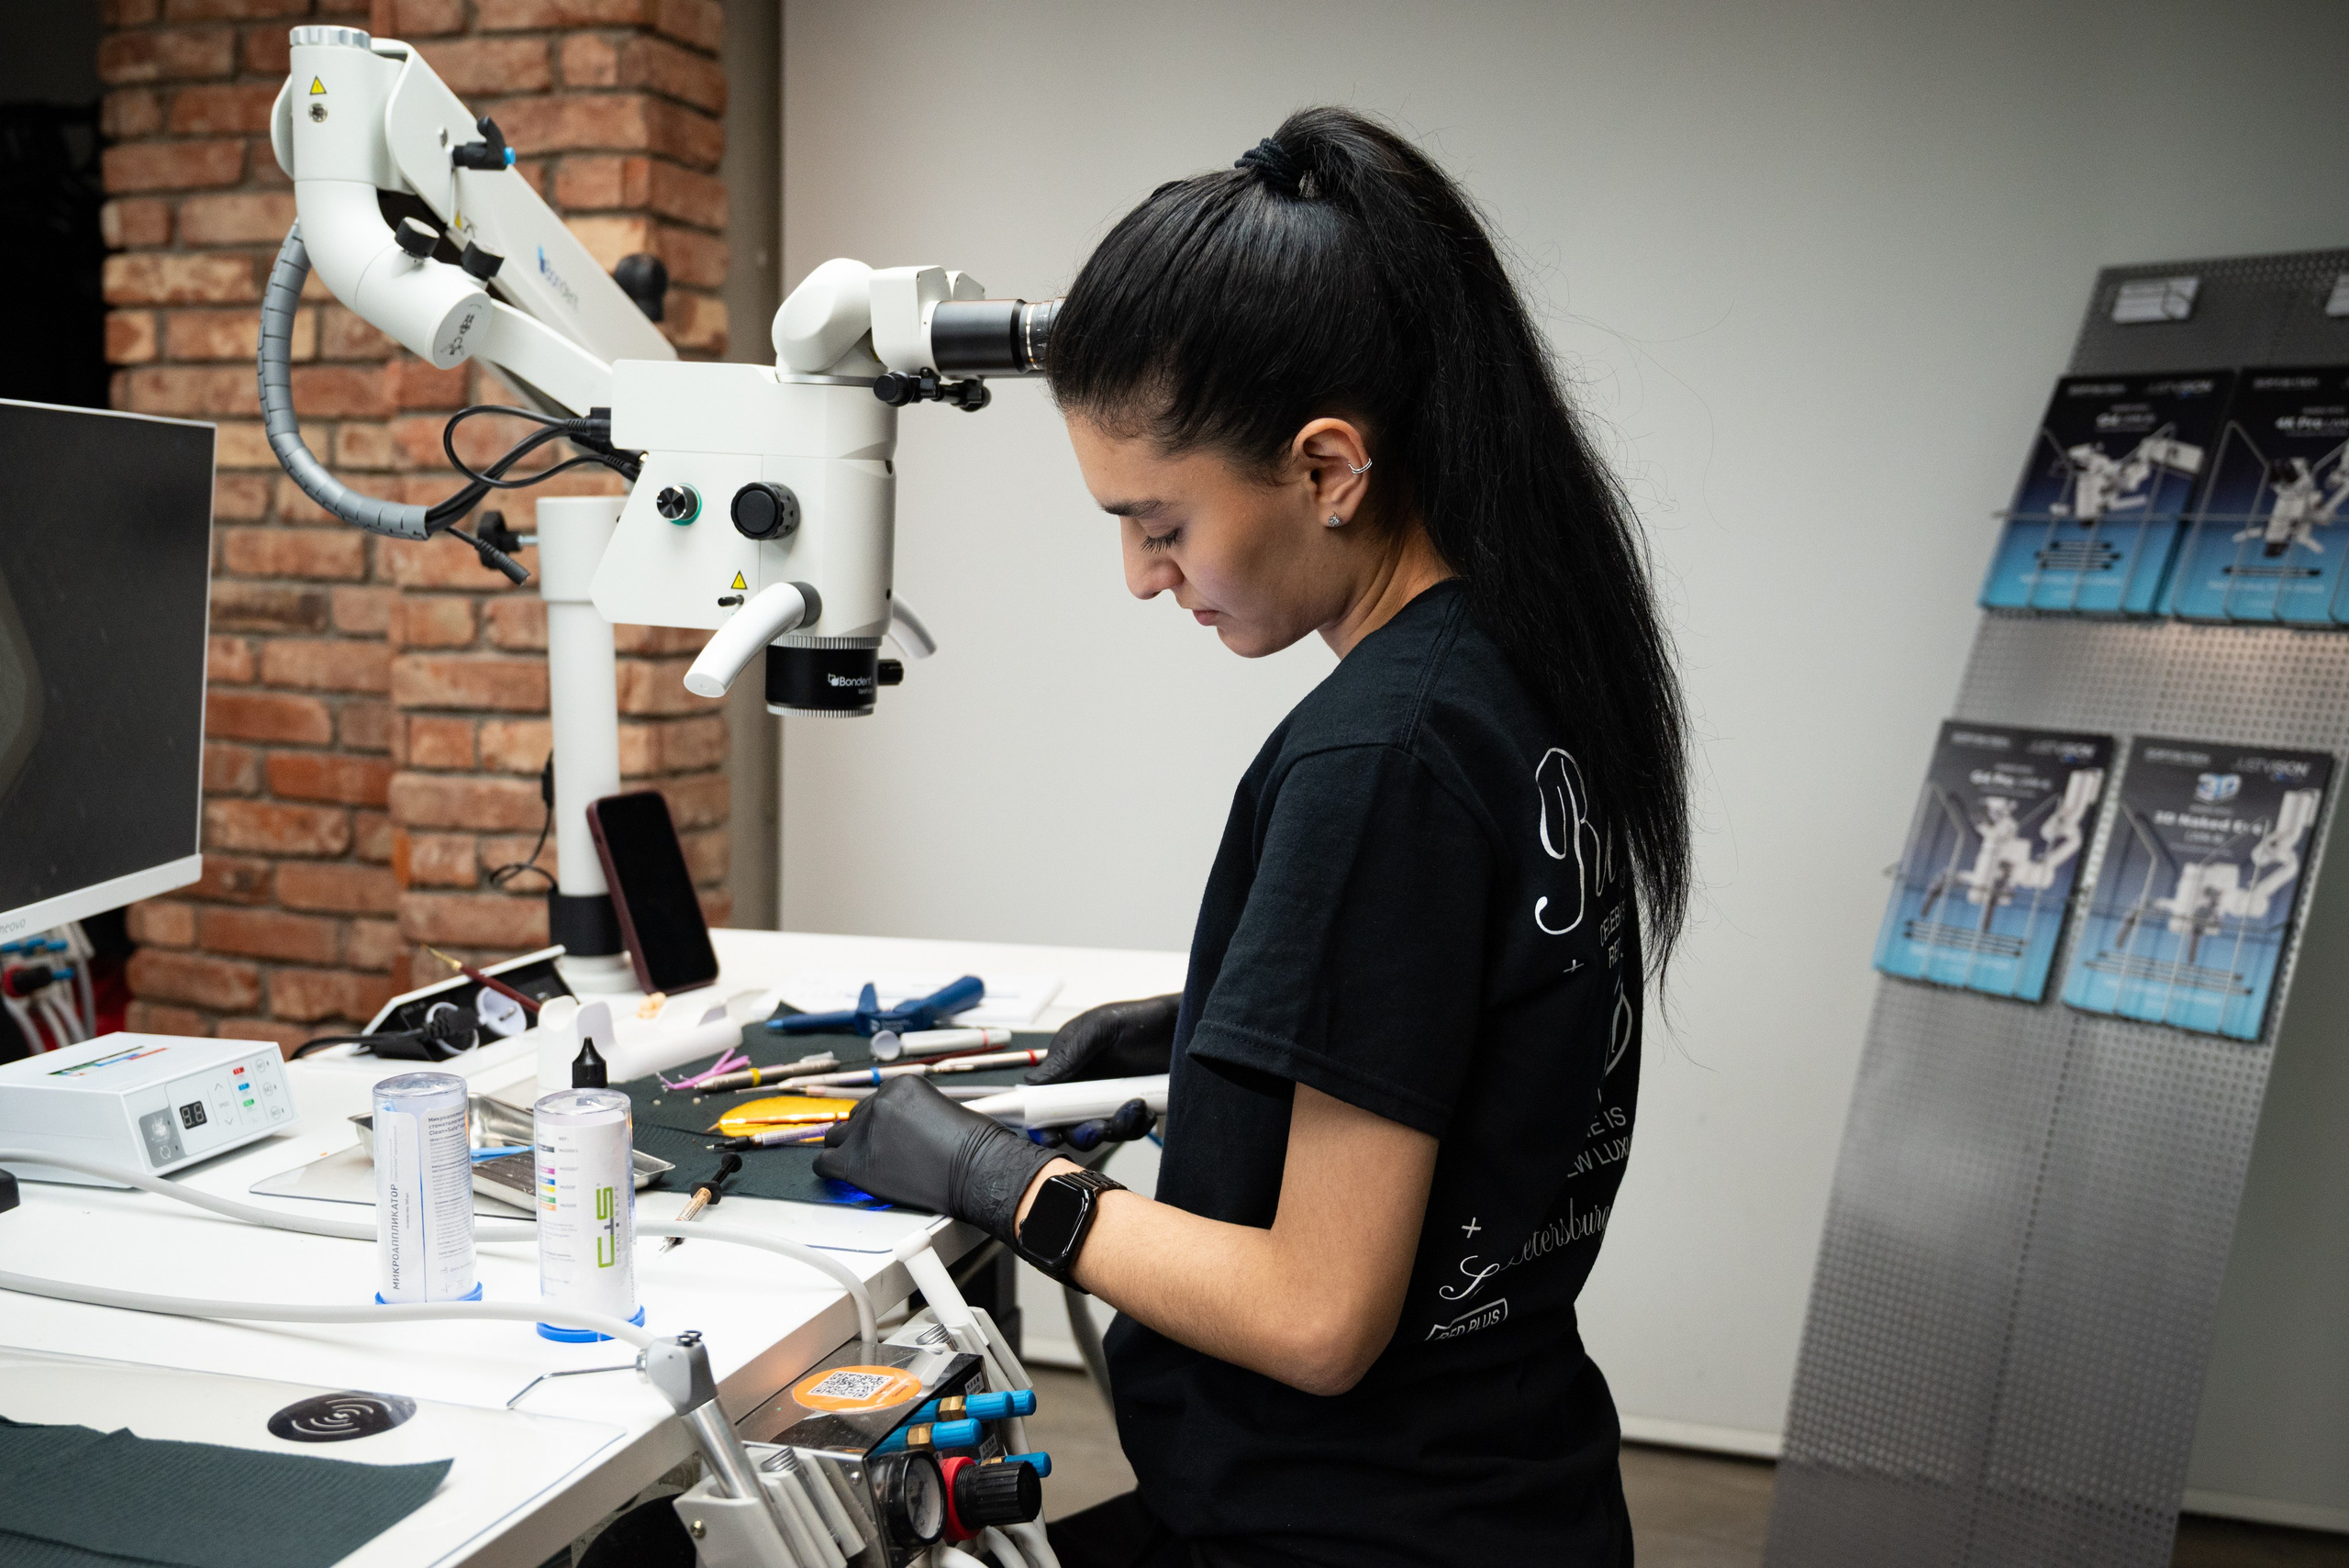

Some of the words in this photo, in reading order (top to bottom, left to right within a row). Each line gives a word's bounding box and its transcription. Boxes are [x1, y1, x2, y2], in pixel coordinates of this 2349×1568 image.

[839, 676, 872, 687] Bondent
[1603, 1106, 1627, 1129] IS
[390, 1184, 400, 1290] МИКРОАППЛИКАТОР
[1500, 1197, 1610, 1273] etersburg
[1468, 1309, 1500, 1334] PLUS
